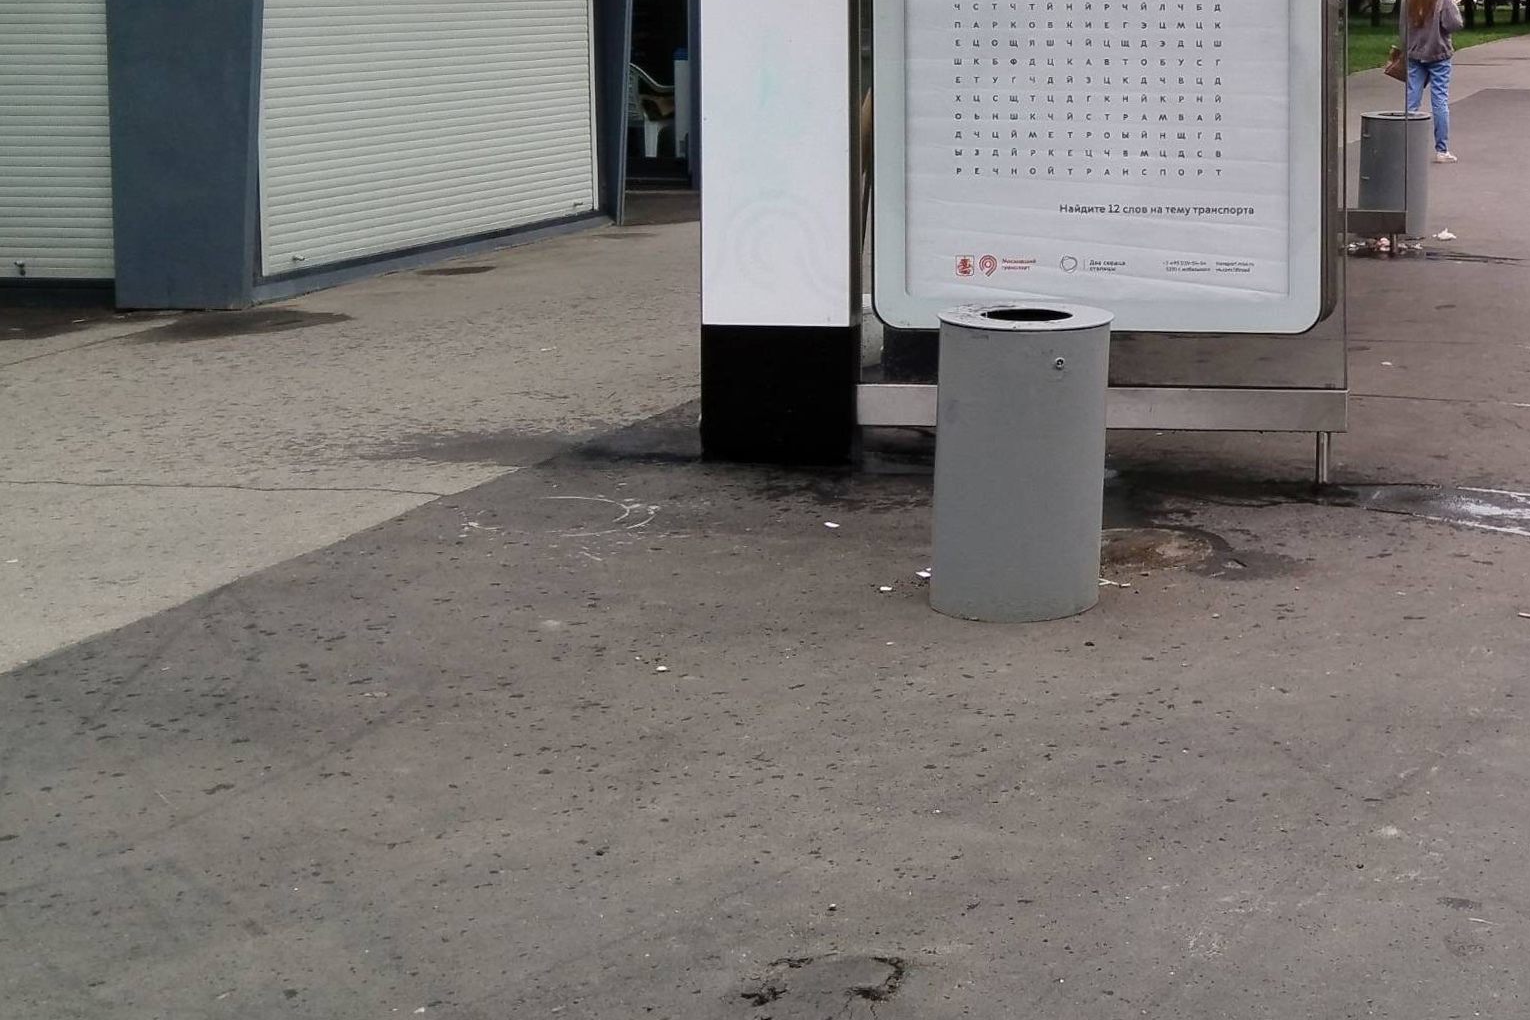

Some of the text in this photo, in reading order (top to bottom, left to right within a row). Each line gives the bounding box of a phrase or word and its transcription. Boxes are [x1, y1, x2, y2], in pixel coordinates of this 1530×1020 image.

[1060, 204, 1106, 214] Найдите
[1108, 204, 1120, 213] 12
[1122, 206, 1148, 214] слов
[1165, 207, 1191, 216] тему
[1193, 206, 1254, 216] транспорта
